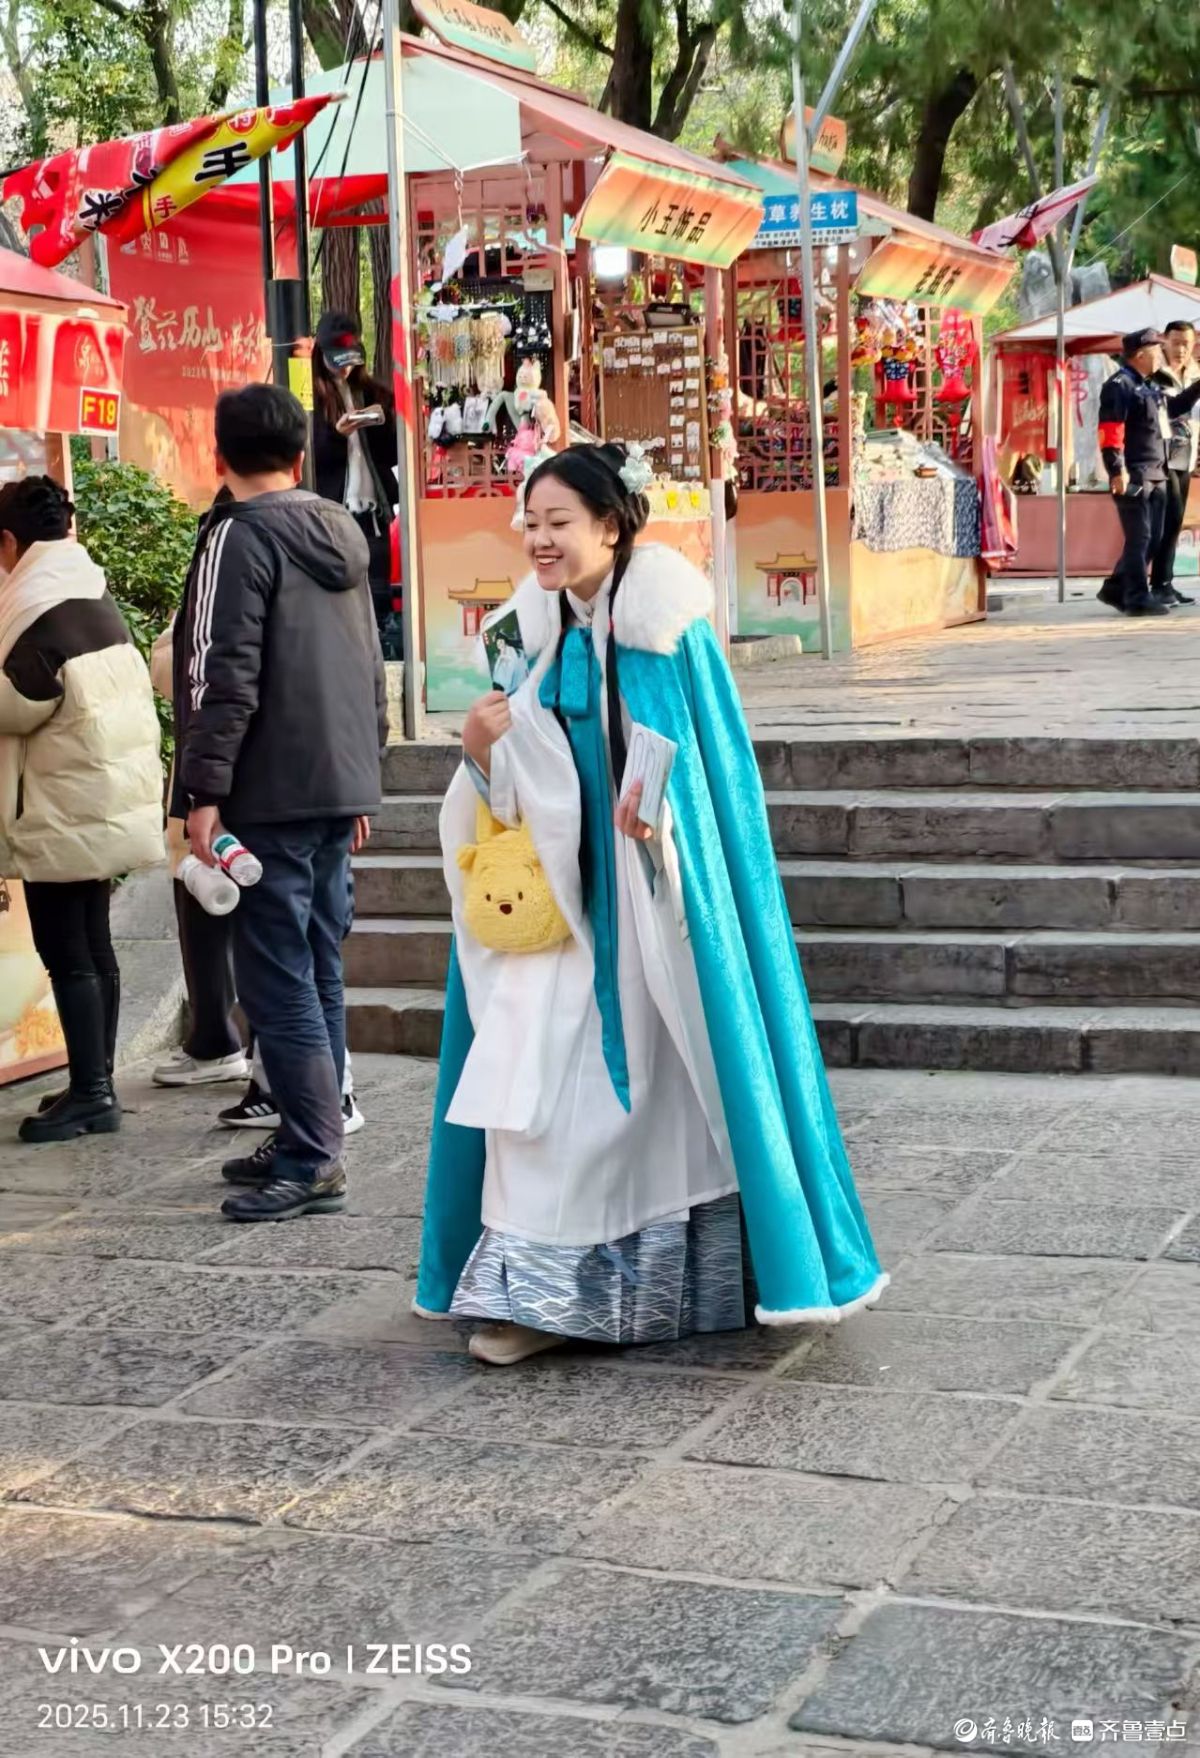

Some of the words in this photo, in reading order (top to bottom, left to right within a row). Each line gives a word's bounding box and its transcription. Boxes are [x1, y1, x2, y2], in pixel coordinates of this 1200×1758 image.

[640, 198, 712, 245] 小玉饰品
[83, 396, 116, 426] F19
